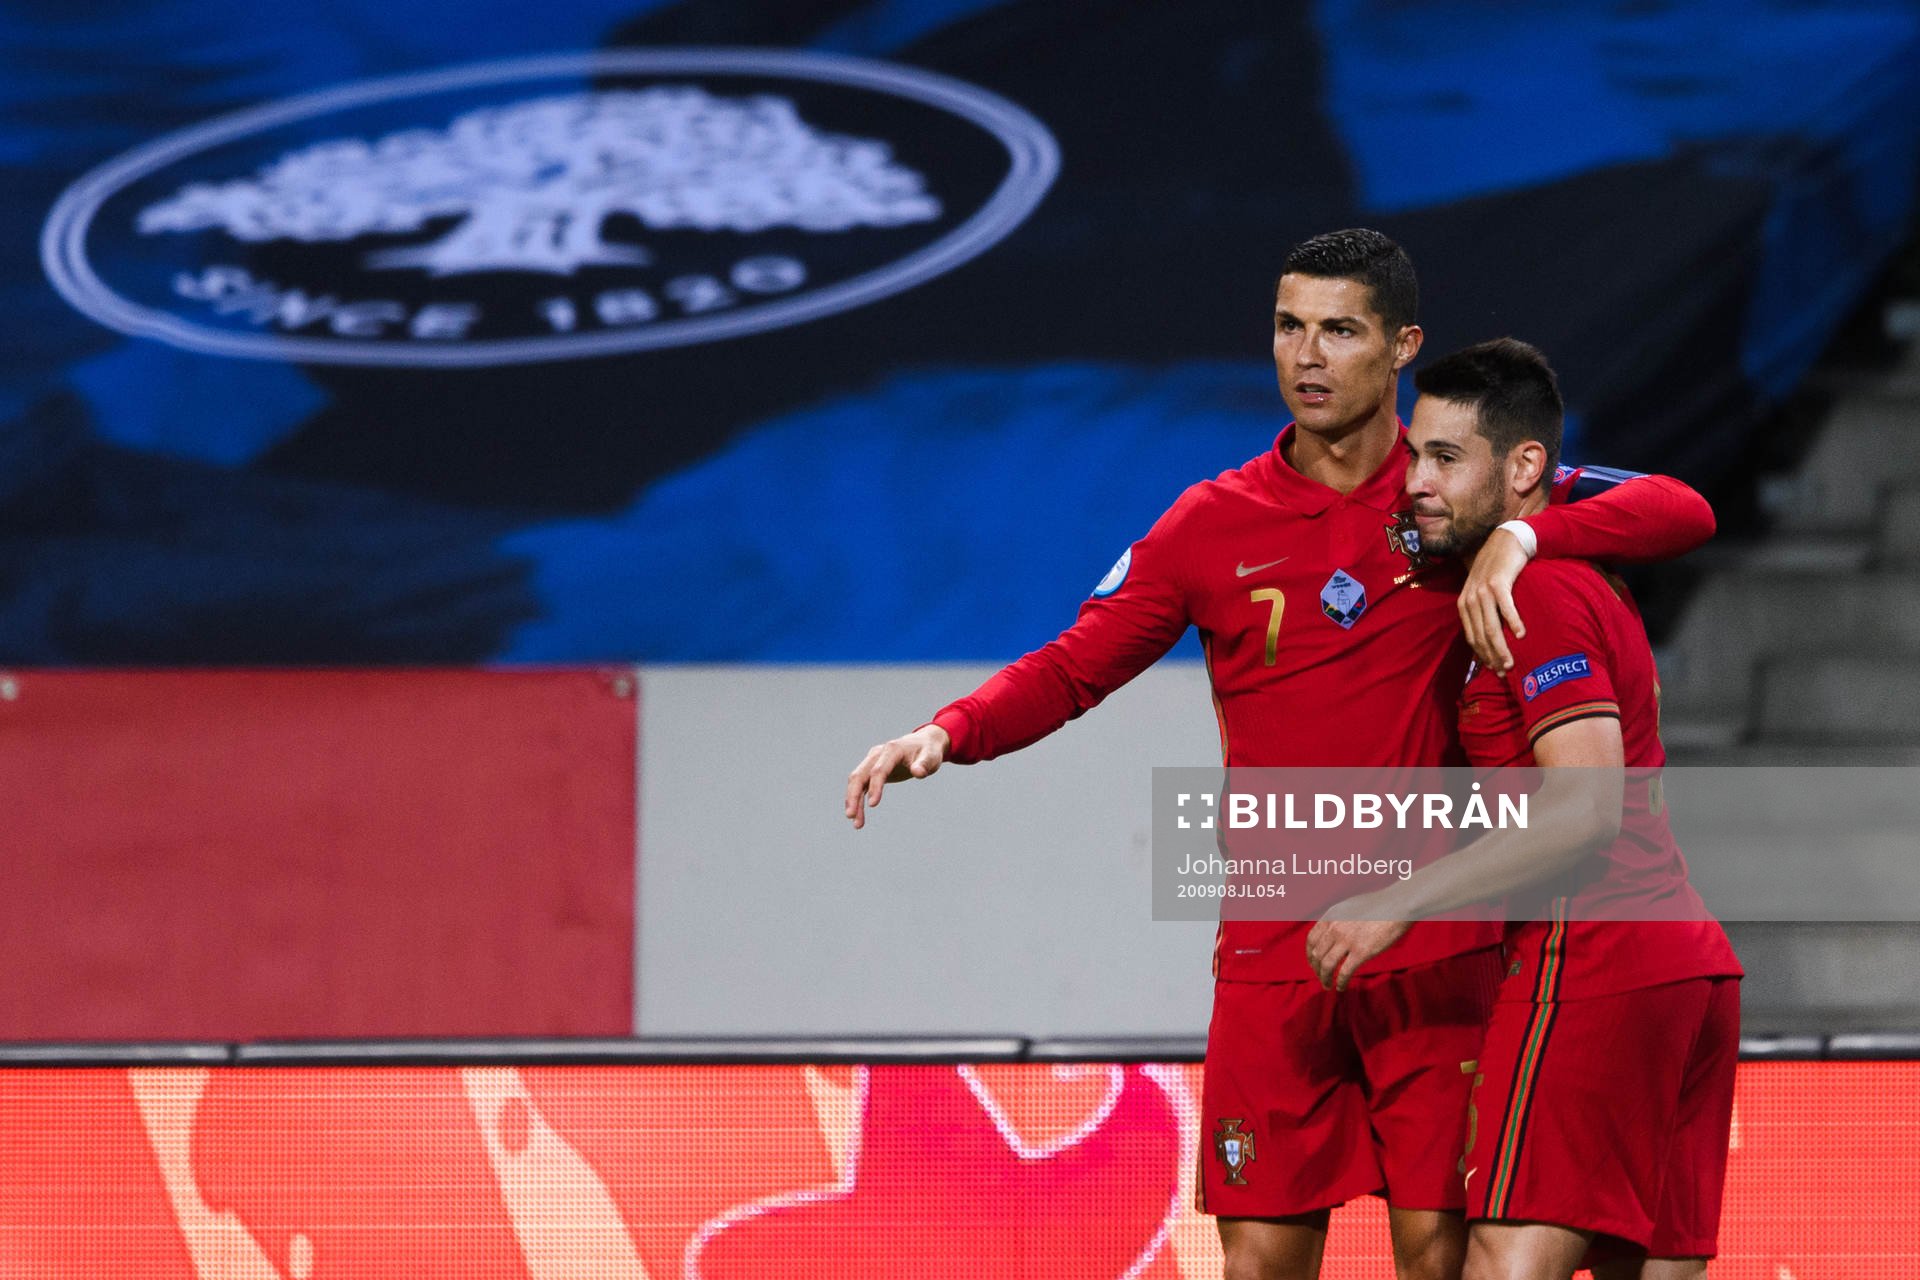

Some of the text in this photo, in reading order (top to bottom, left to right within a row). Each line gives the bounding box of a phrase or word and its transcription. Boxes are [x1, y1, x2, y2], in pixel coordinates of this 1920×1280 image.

[174, 253, 806, 338] SINCE 1820
[1250, 588, 1285, 666] 7
[1537, 659, 1588, 686] RESPECT
